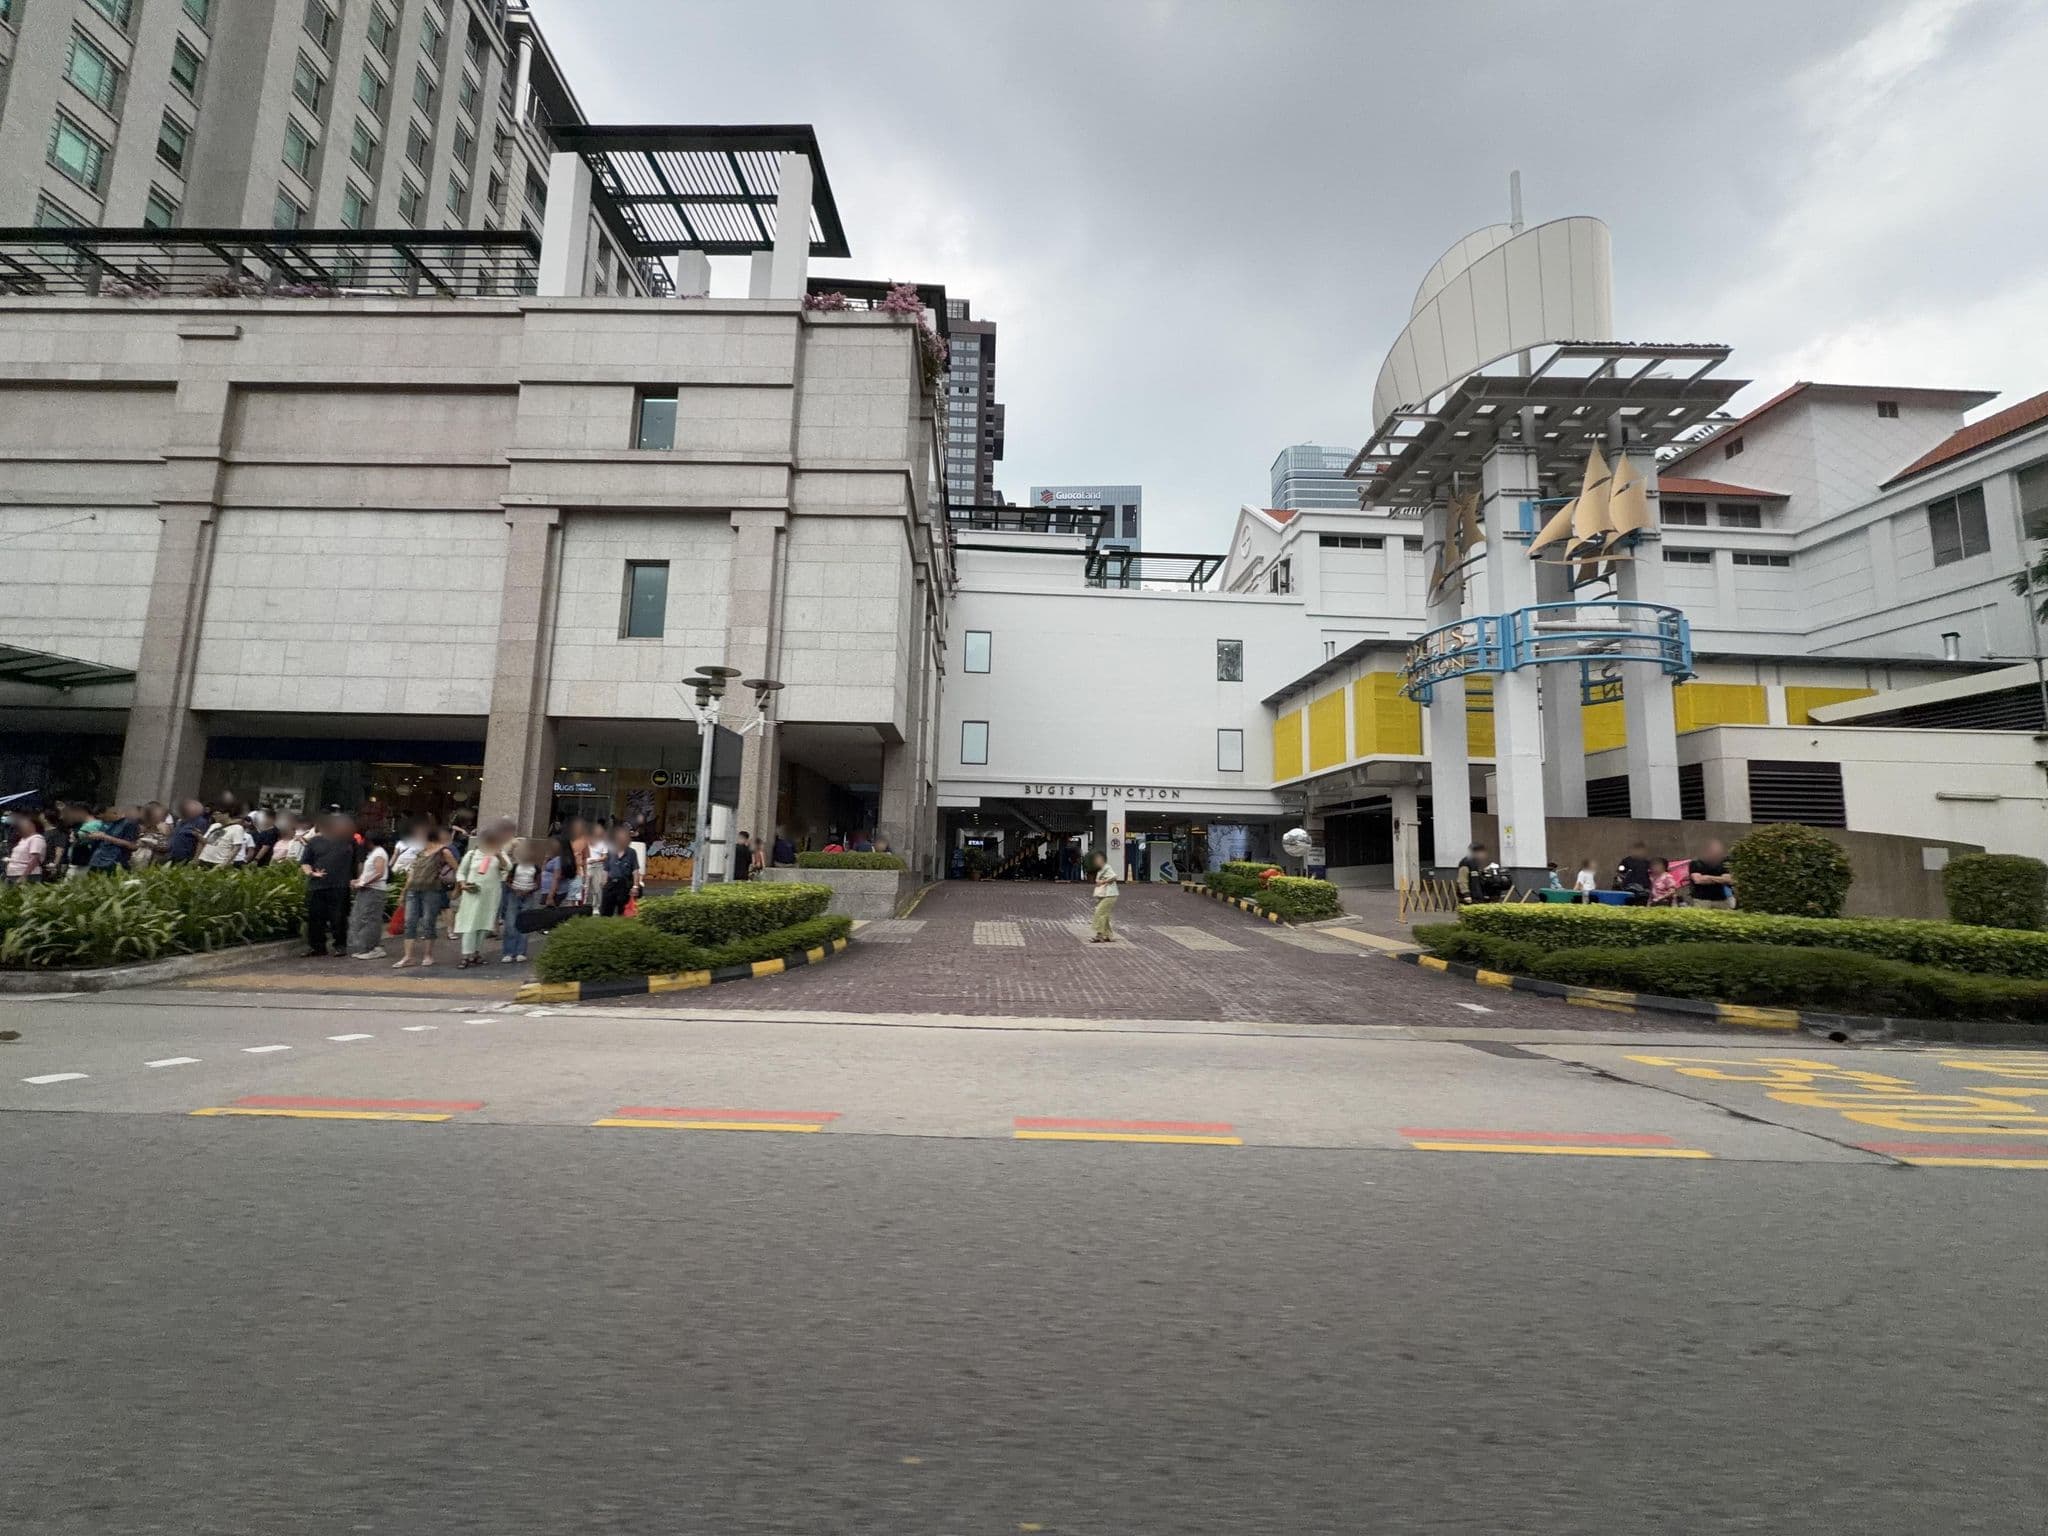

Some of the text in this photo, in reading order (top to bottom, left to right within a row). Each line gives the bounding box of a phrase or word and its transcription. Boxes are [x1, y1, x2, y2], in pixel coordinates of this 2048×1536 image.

[1055, 491, 1101, 500] GuocoLand
[1025, 785, 1181, 799] BUGIS JUNCTION
